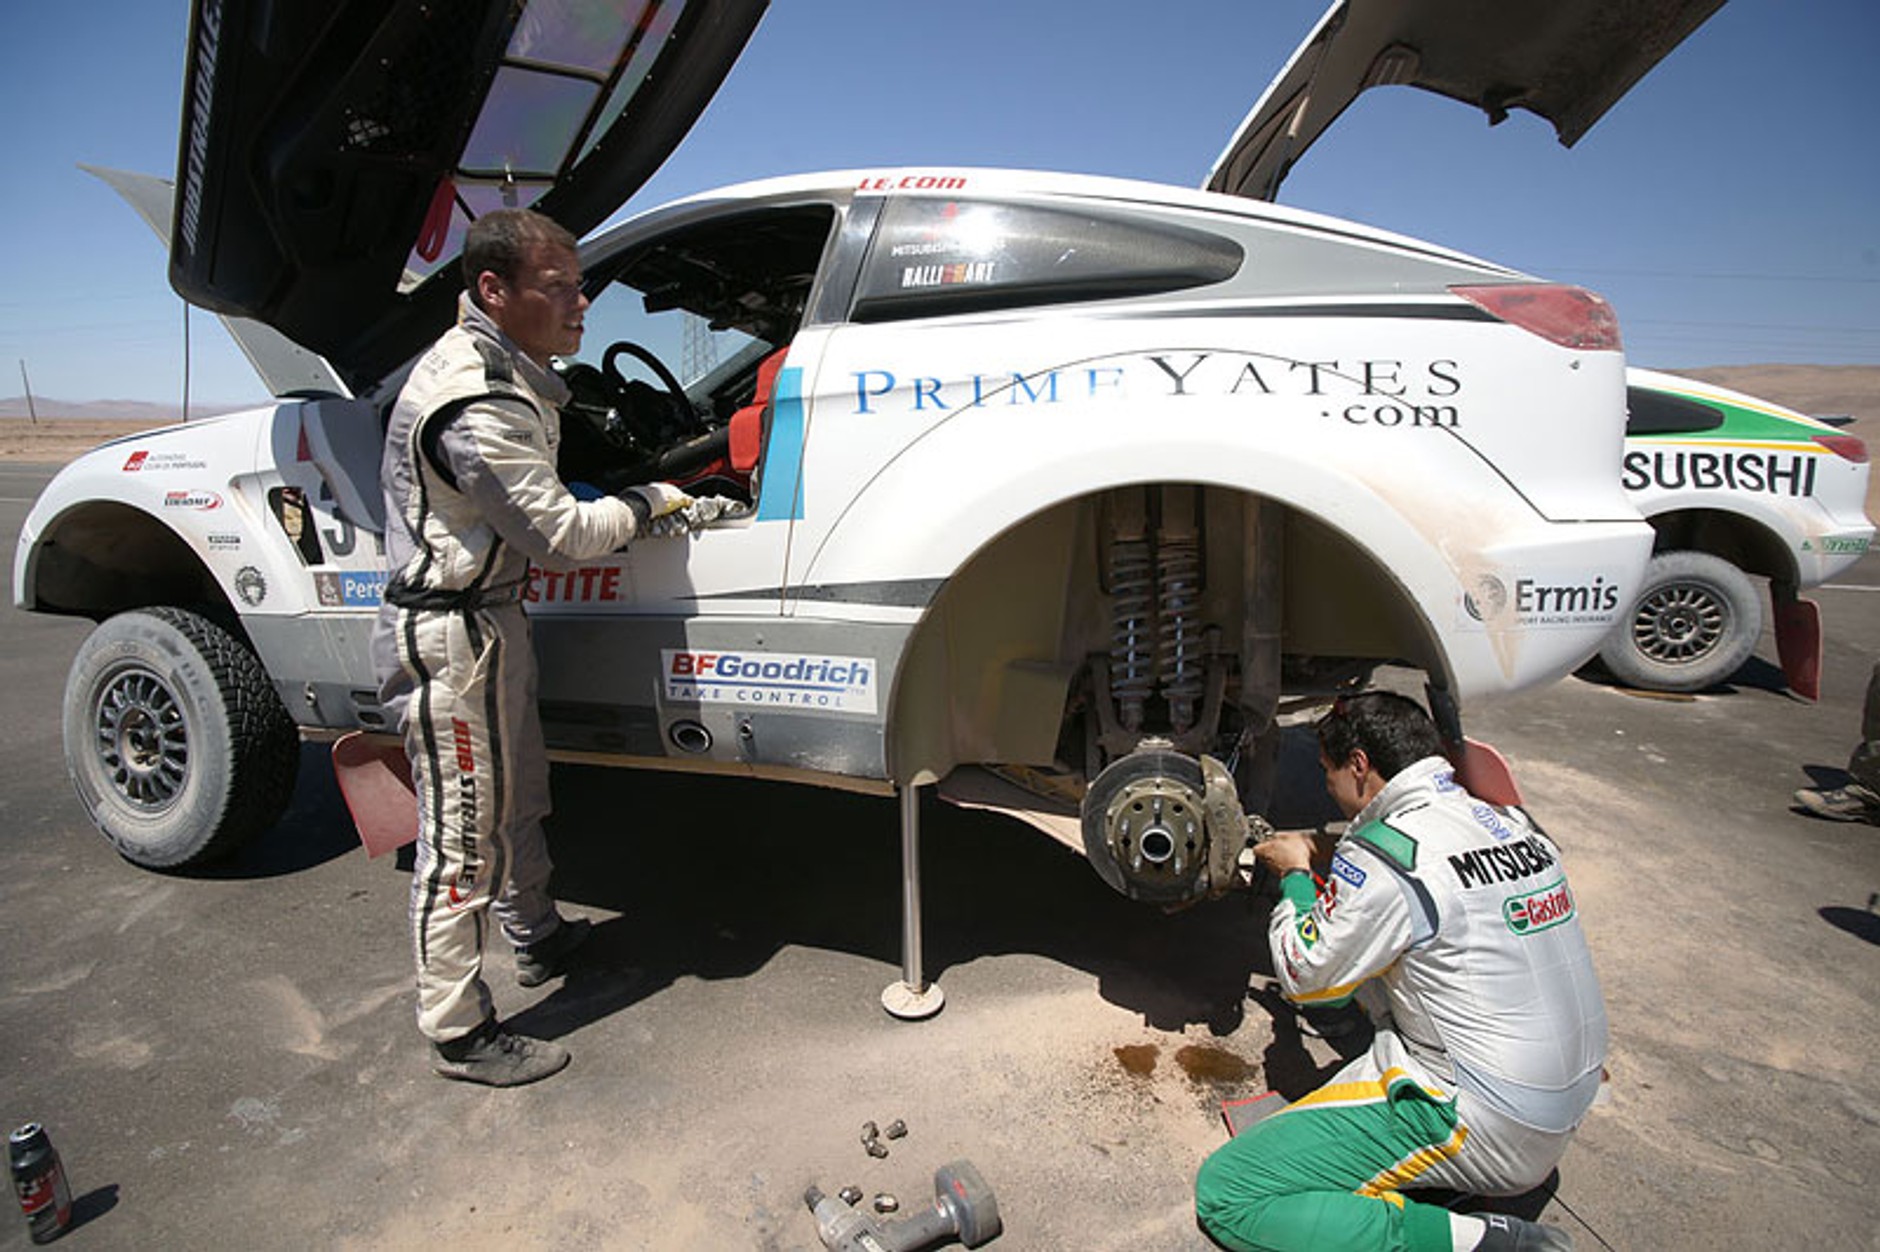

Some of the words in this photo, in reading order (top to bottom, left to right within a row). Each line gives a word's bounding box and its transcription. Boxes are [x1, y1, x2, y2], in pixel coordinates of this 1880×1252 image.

[1622, 451, 1818, 497] SUBISHI
[345, 579, 386, 598] Pers
[526, 566, 621, 602] CTITE
[1516, 576, 1618, 612] Ermis
[671, 653, 868, 685] BFGoodrich
[669, 686, 720, 699] TAKE
[737, 690, 842, 707] CONTROL
